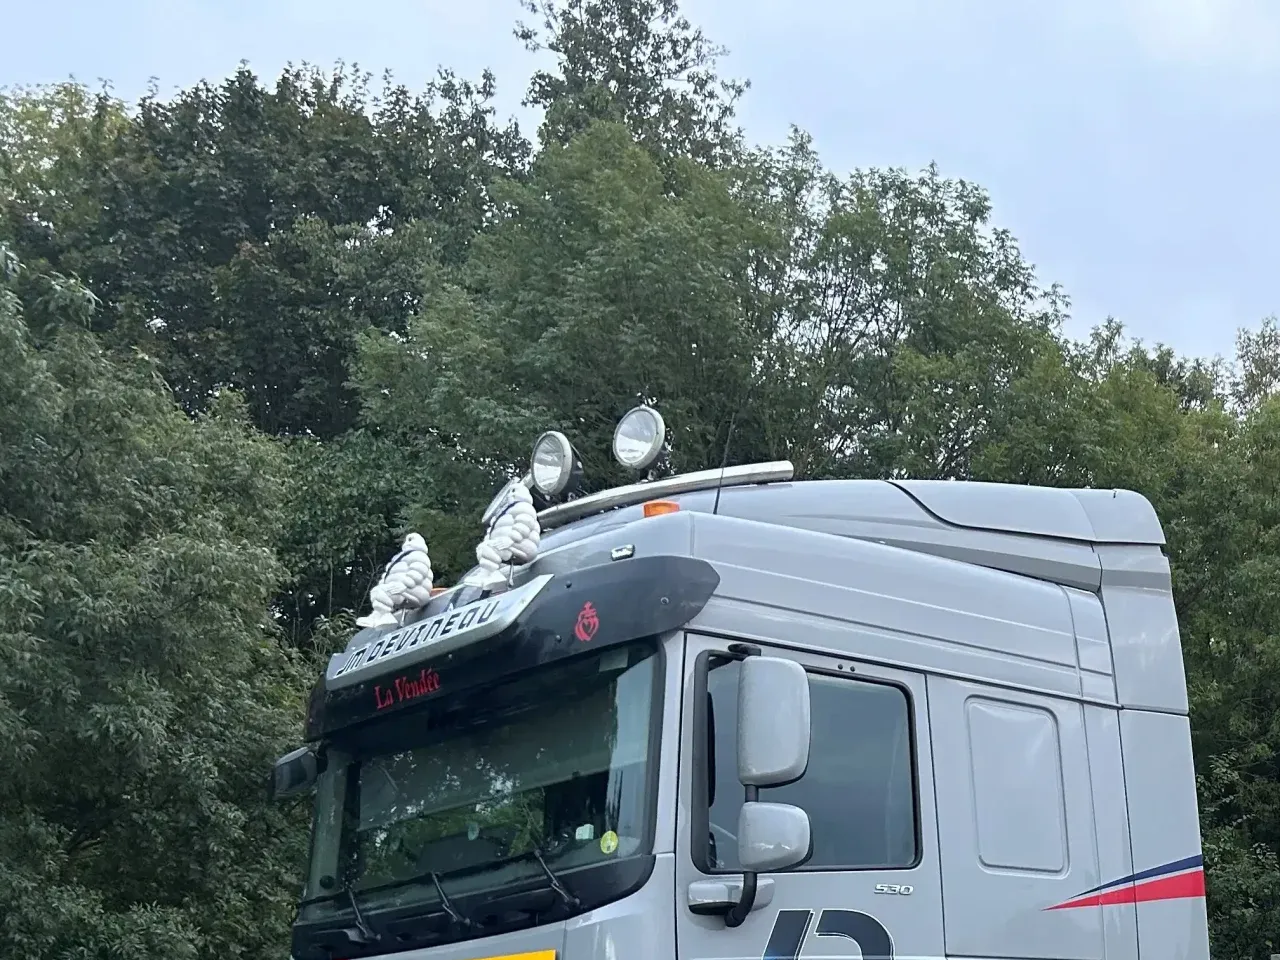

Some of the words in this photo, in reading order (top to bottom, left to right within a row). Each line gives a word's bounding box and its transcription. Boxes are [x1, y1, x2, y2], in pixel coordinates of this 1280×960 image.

[336, 647, 368, 676] JM
[366, 600, 500, 663] DEVINEAU
[374, 685, 394, 709] La
[395, 667, 442, 702] Vendée
[874, 883, 914, 896] 530
